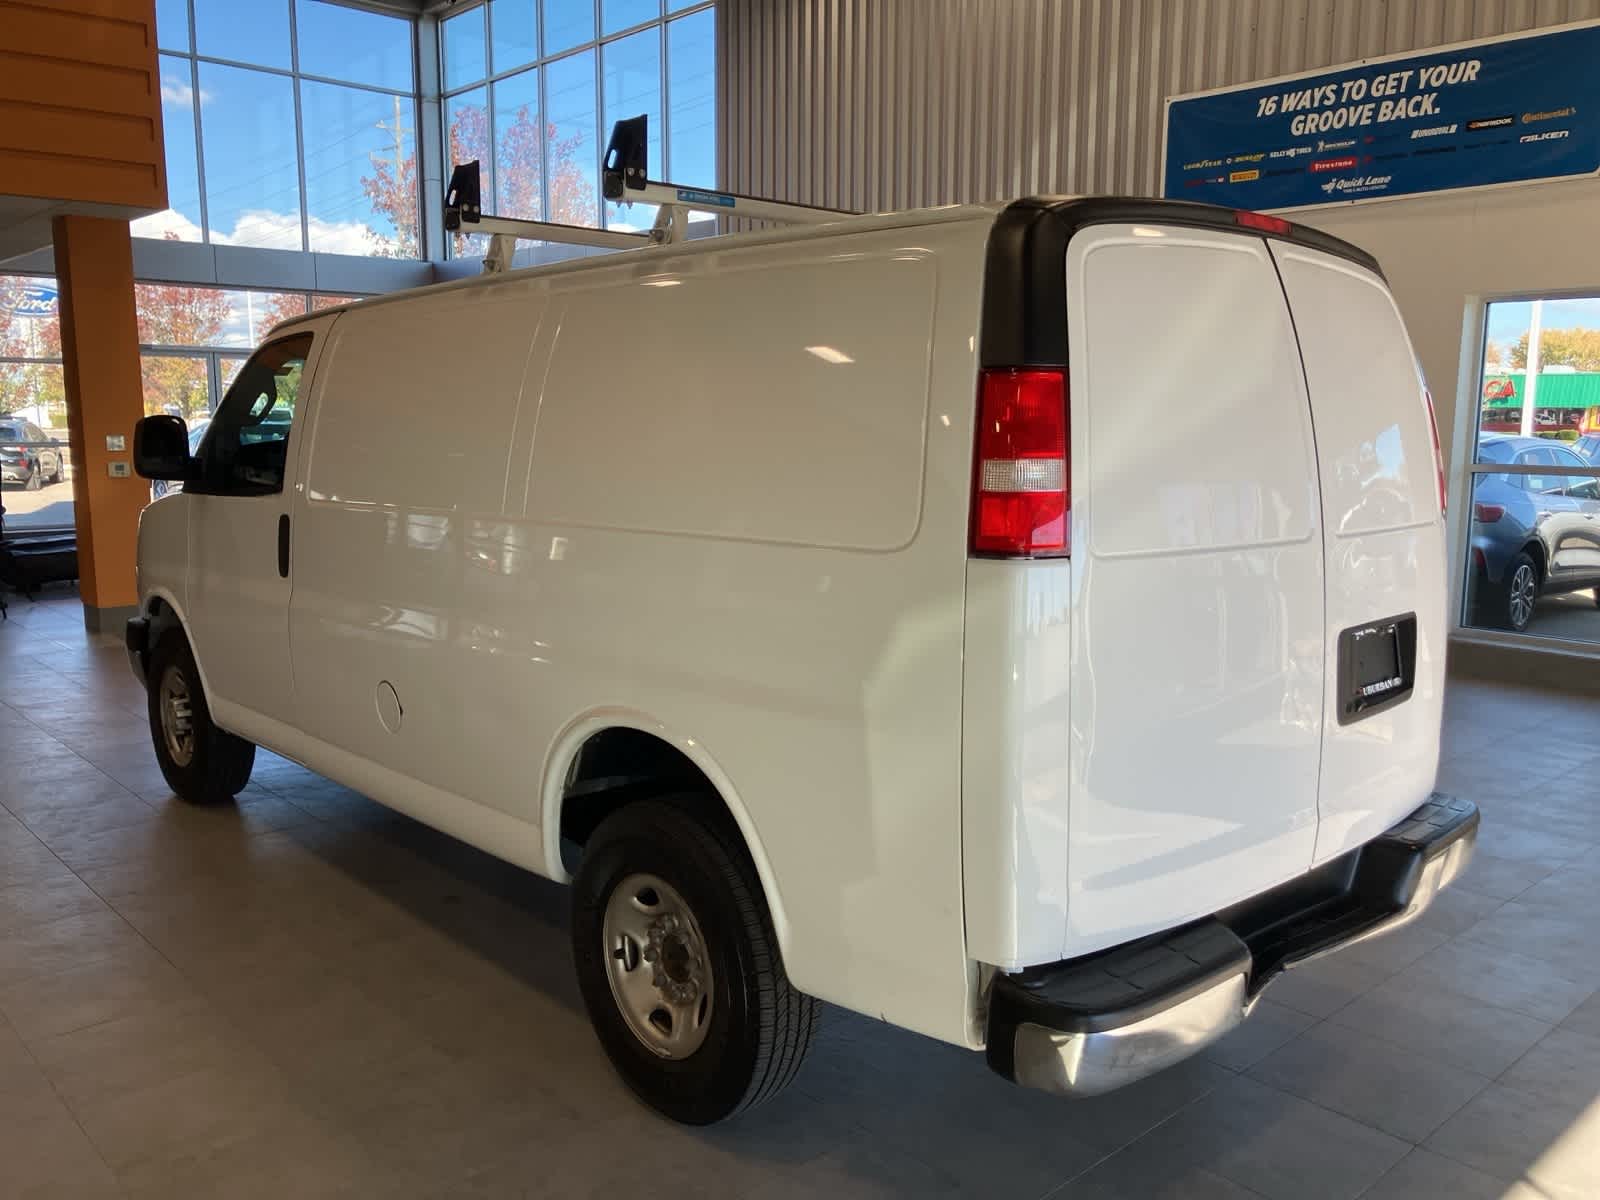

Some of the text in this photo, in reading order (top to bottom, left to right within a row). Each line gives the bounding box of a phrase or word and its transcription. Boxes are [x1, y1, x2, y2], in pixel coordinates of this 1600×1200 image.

[1257, 60, 1481, 117] 16 WAYS TO GET YOUR
[1291, 93, 1440, 136] GROOVE BACK.
[1520, 130, 1569, 143] FALKEN
[1336, 176, 1365, 190] Quick
[1365, 176, 1392, 186] Lane
